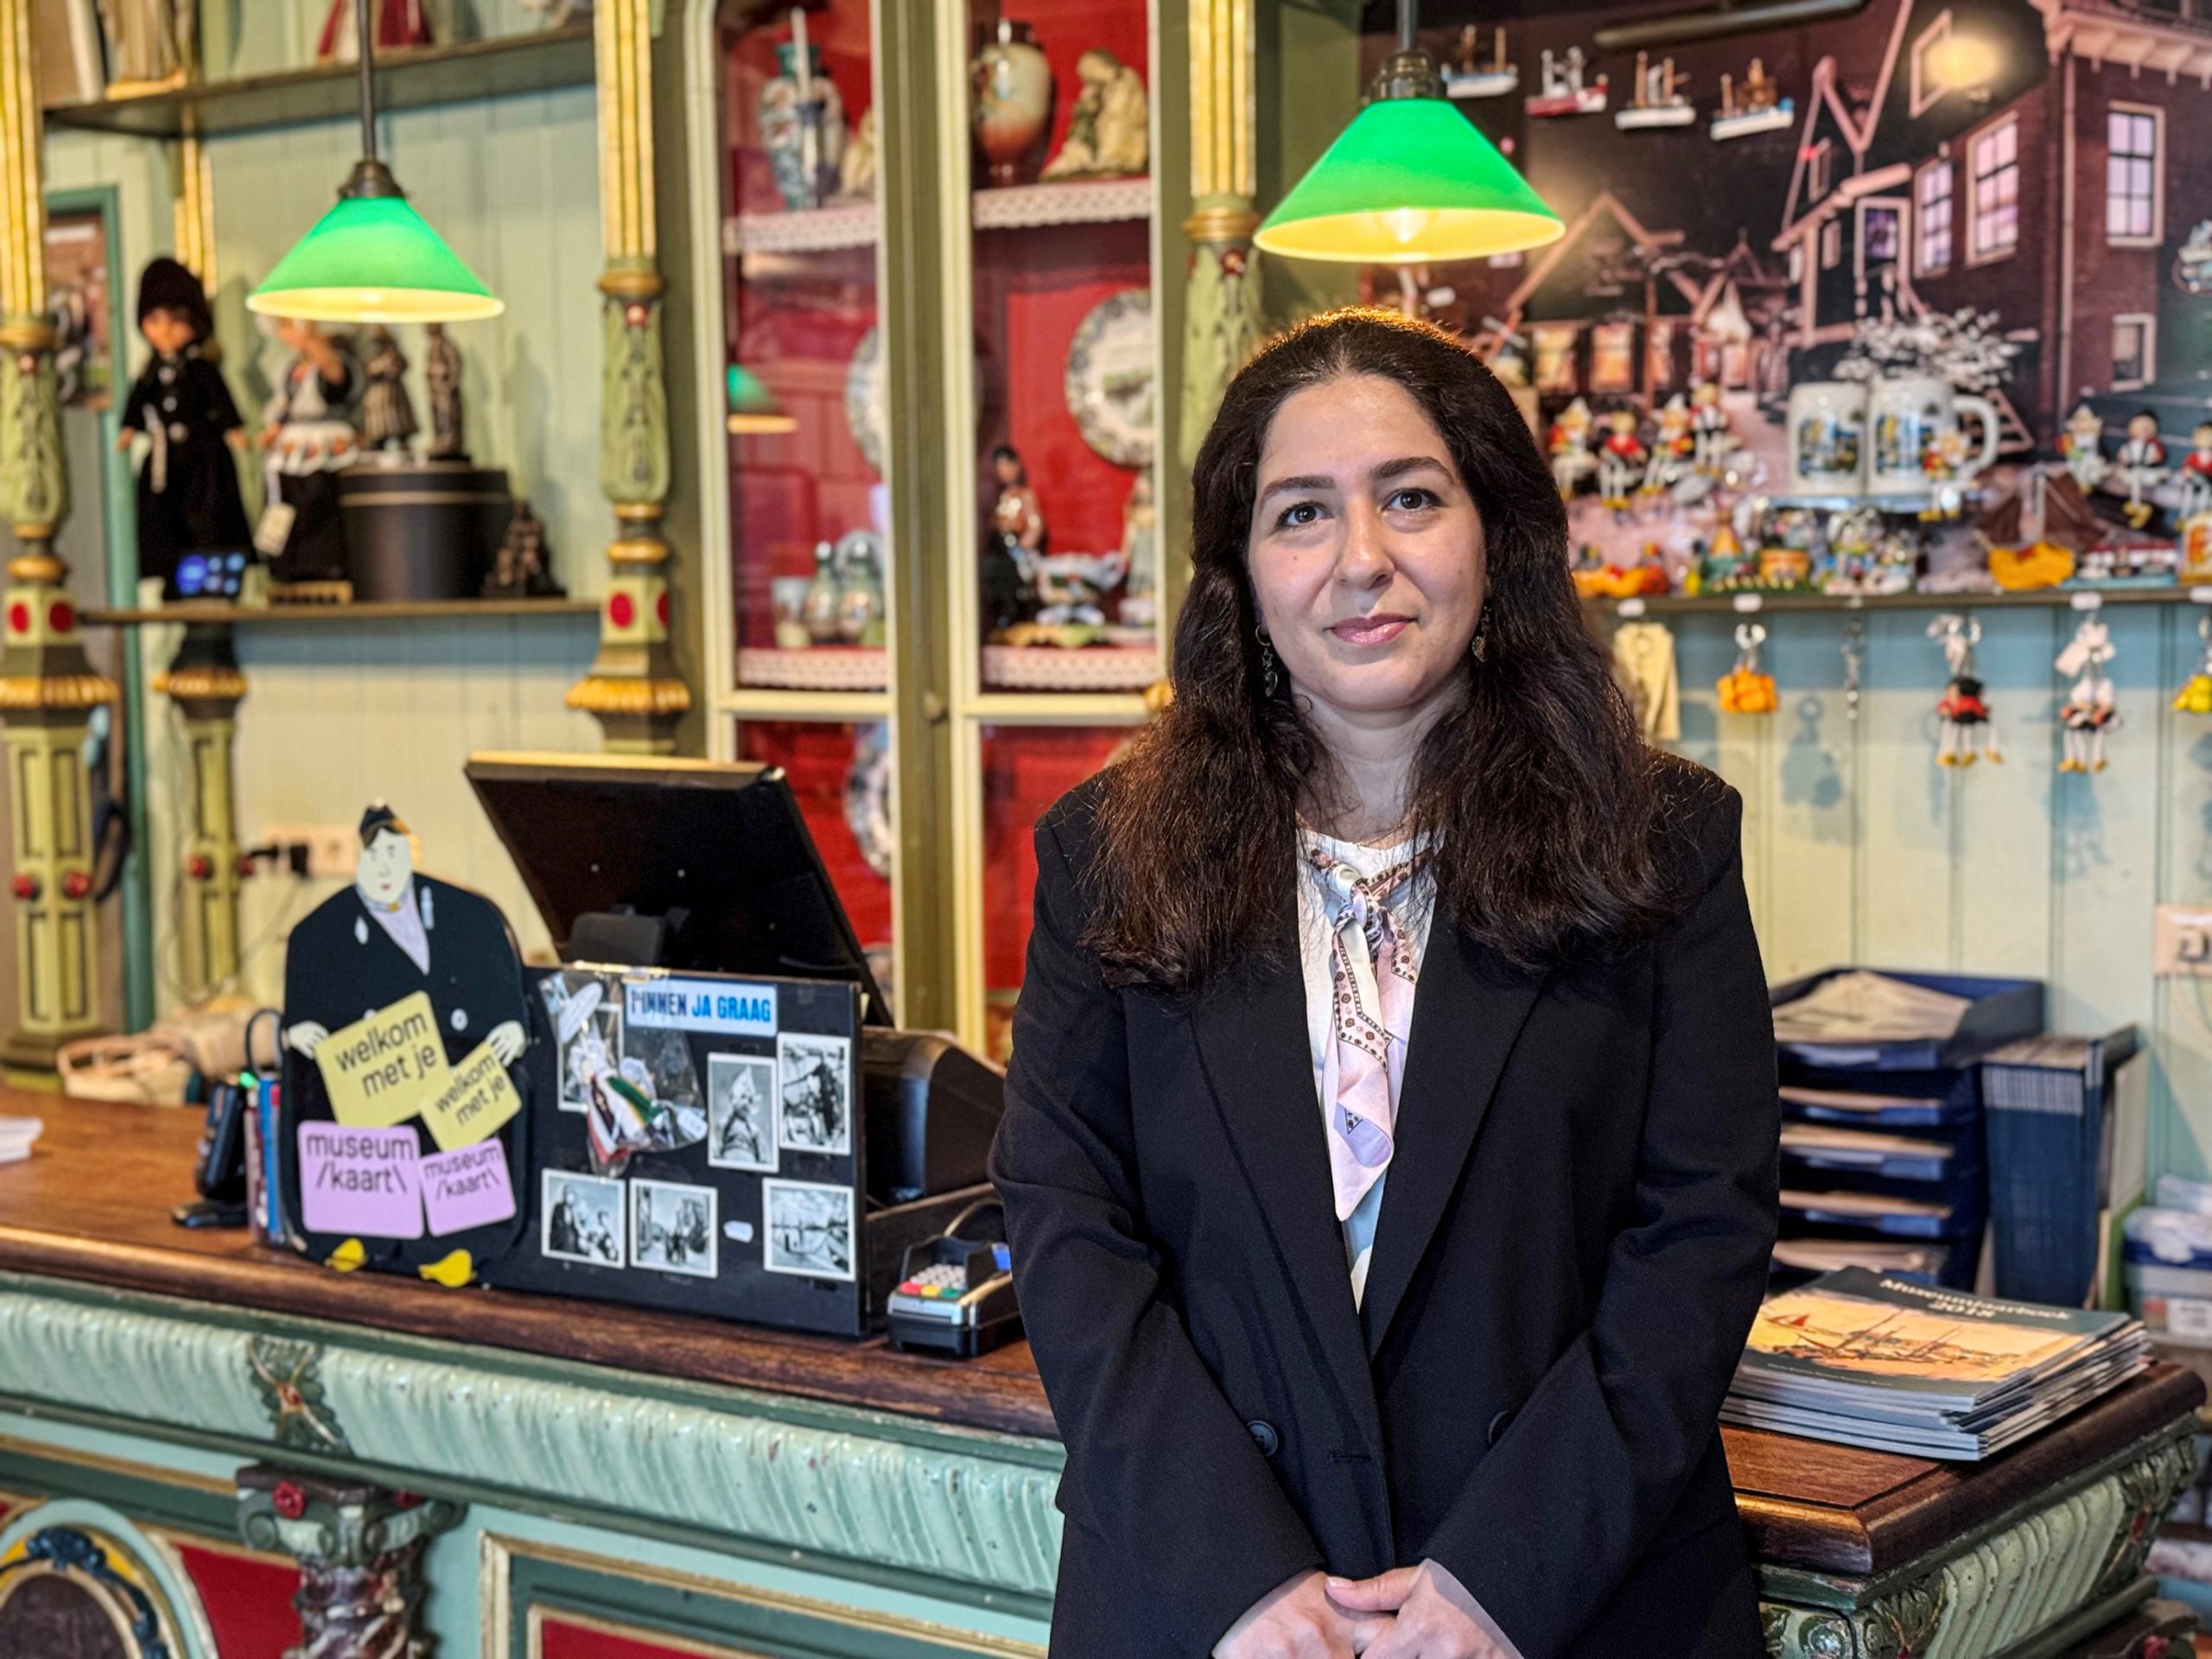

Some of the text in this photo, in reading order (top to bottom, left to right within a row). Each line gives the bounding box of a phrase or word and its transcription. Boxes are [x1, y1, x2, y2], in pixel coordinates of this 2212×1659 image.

[691, 994, 712, 1020] JA
[716, 995, 772, 1023] GRAAG
[334, 1012, 429, 1072] welkom
[361, 1043, 436, 1098] met je
[435, 1054, 497, 1114] welkom
[455, 1074, 505, 1126] met je
[306, 1134, 414, 1161] museum
[423, 1145, 501, 1179] museum
